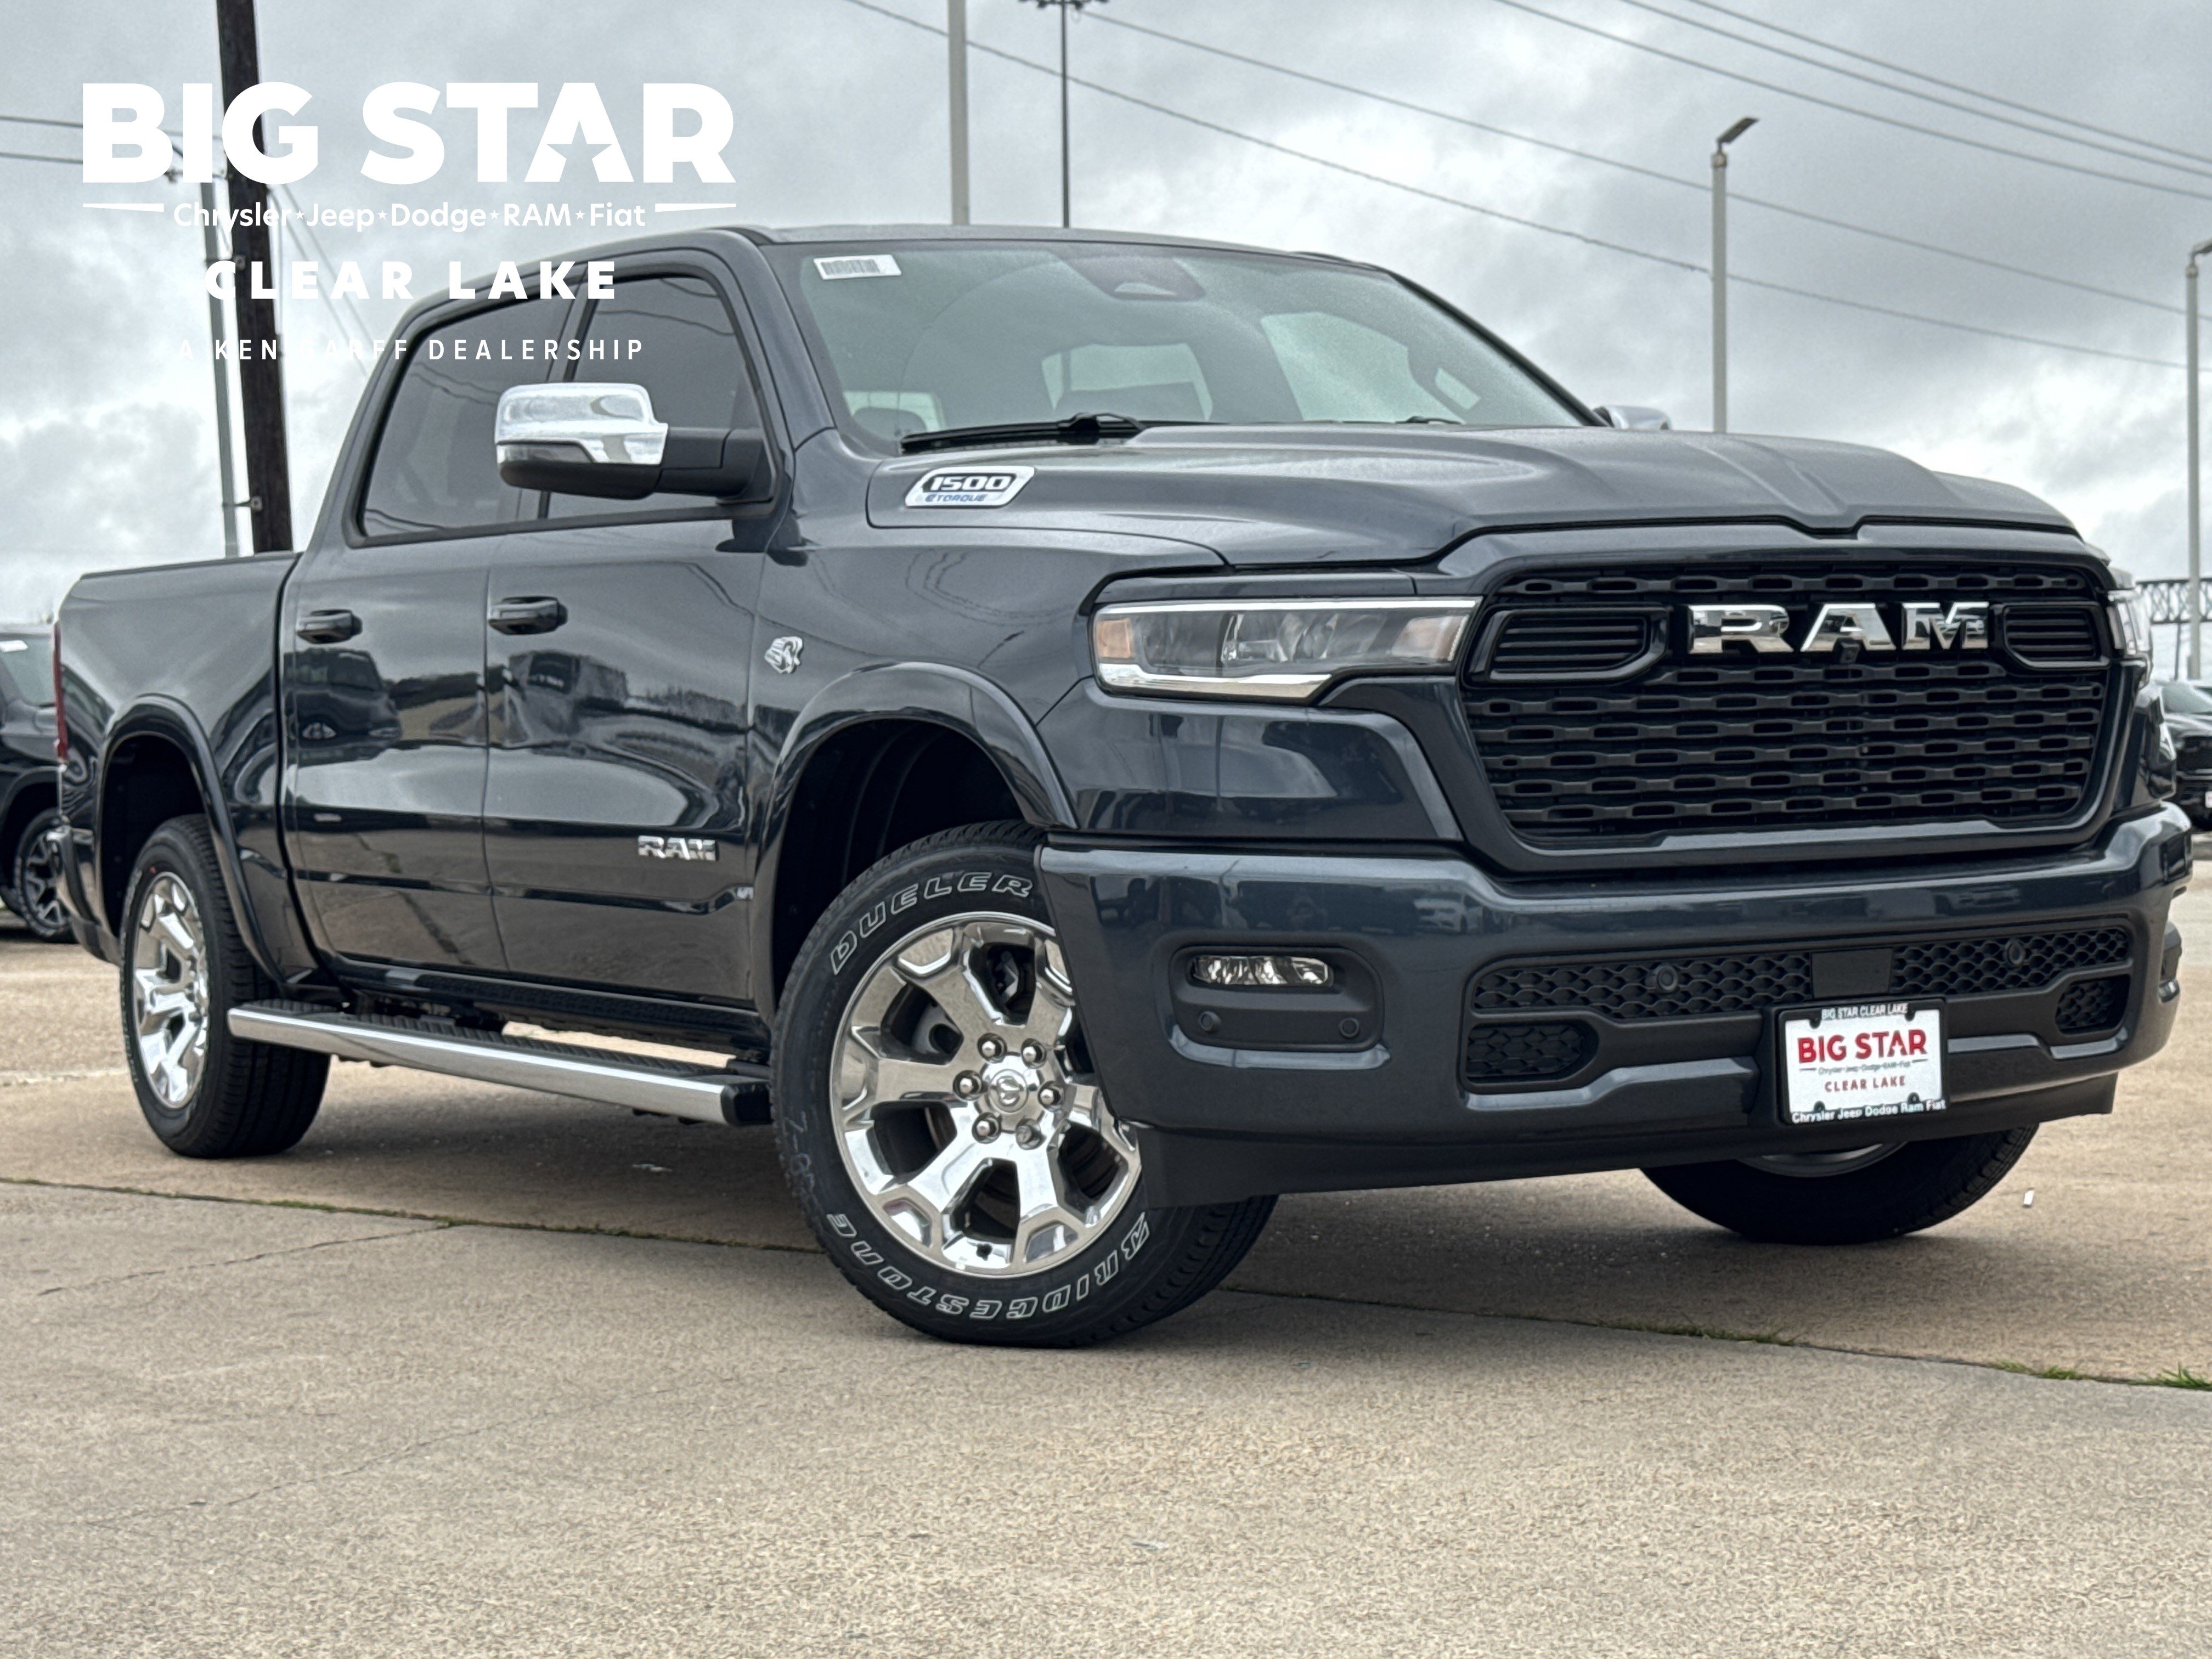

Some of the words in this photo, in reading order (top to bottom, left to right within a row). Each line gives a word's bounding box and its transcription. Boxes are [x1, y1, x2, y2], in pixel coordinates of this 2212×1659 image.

[930, 476, 1013, 491] 1500
[1688, 601, 1989, 654] RAM
[637, 835, 716, 862] RAM
[829, 871, 1034, 975] DUELER
[1821, 1008, 1836, 1020] BIG
[1837, 1006, 1859, 1019] STAR
[1860, 1005, 1886, 1016] CLEAR
[1887, 1002, 1909, 1014] LAKE
[1797, 1034, 1847, 1064] BIG
[1854, 1029, 1928, 1059] STAR
[1824, 1078, 1867, 1093] CLEAR
[1872, 1075, 1906, 1088] LAKE
[1792, 1110, 1835, 1124] Chrysler
[1838, 1107, 1863, 1120] Jeep
[1865, 1105, 1898, 1117] Dodge
[1900, 1102, 1924, 1114] Ram
[1926, 1098, 1947, 1111] Fiat
[826, 1211, 1150, 1320] BRIDGESTONE
